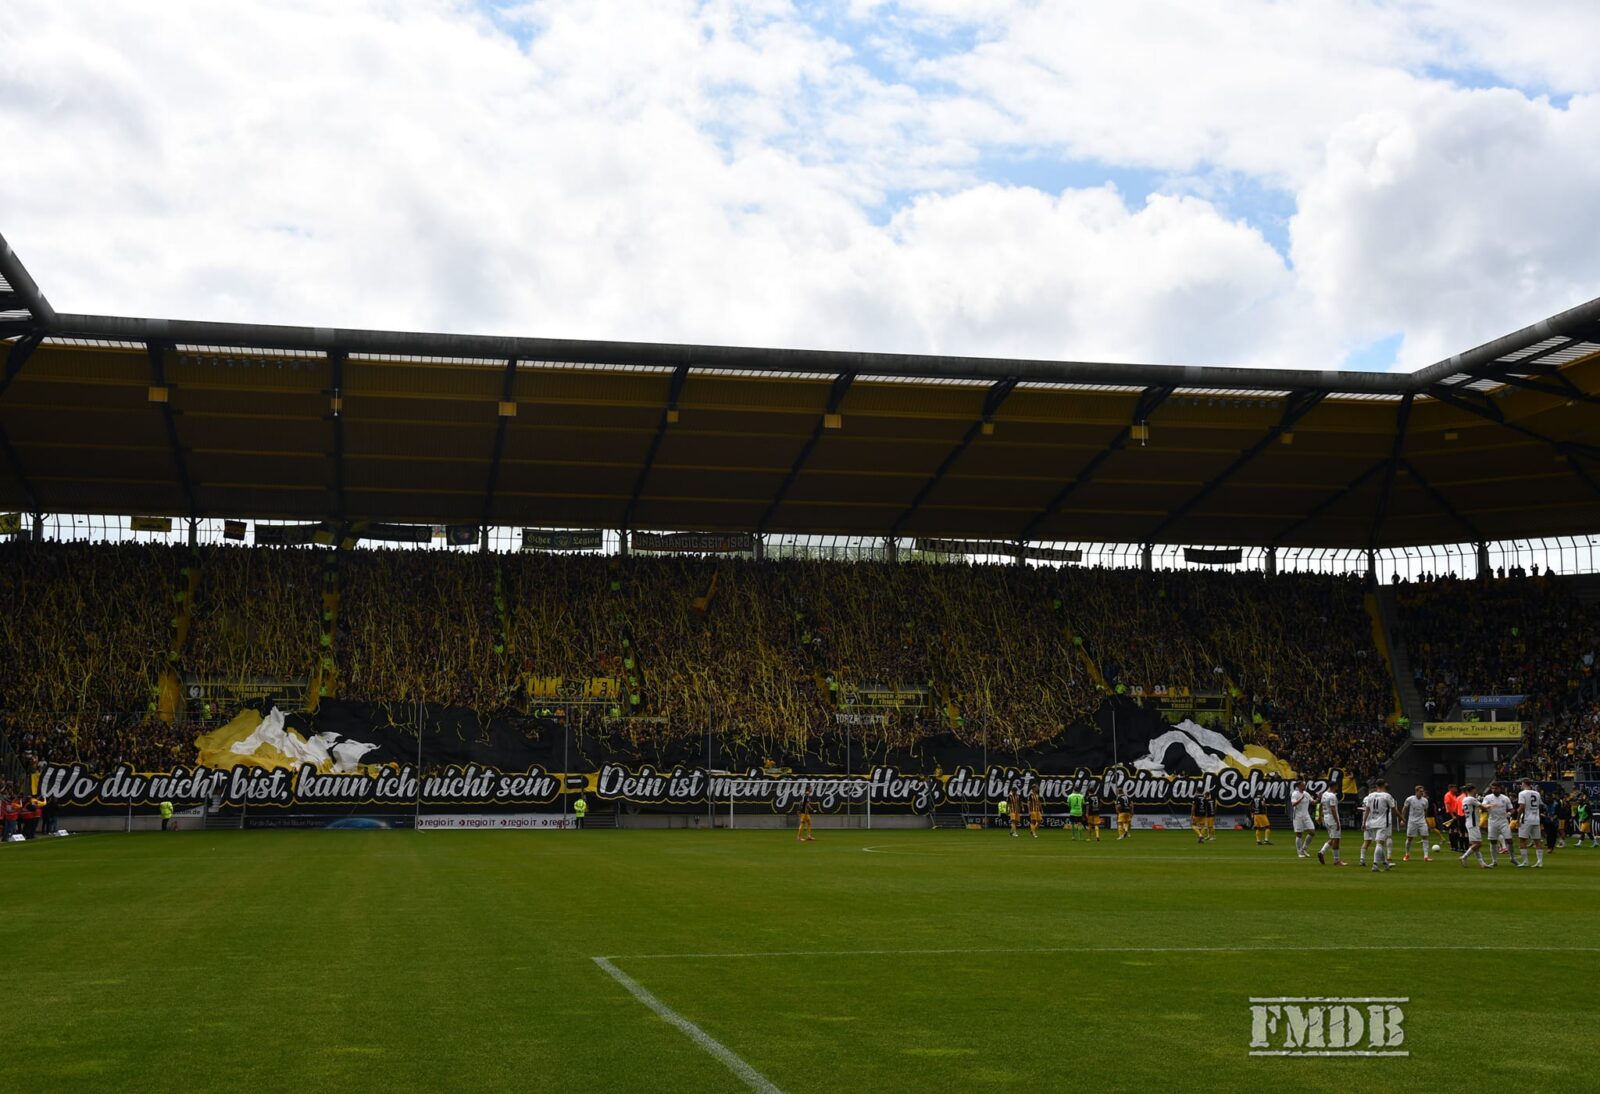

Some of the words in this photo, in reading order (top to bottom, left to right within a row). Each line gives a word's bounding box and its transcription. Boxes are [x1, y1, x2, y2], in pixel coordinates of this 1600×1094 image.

[573, 535, 600, 546] Legion
[728, 536, 750, 548] 1900
[917, 539, 1004, 554] ALEMANNIA
[1022, 547, 1081, 561] AACHEN
[40, 765, 98, 799] Wo
[100, 766, 147, 798] du
[149, 767, 228, 799] nicht
[230, 766, 288, 800] bist,
[297, 765, 373, 798] kann
[375, 766, 419, 798] ich
[423, 766, 495, 798] nicht
[497, 768, 555, 798] sein
[599, 765, 667, 798] Dein
[669, 769, 706, 798] ist
[707, 769, 773, 798] mein
[775, 777, 867, 809] ganzes
[948, 769, 986, 798] du
[988, 768, 1036, 798] bist
[1104, 769, 1169, 799] Reim
[1373, 799, 1379, 809] 11
[1530, 795, 1537, 807] 2
[424, 819, 445, 827] regio
[466, 819, 487, 827] regio
[508, 819, 529, 827] regio
